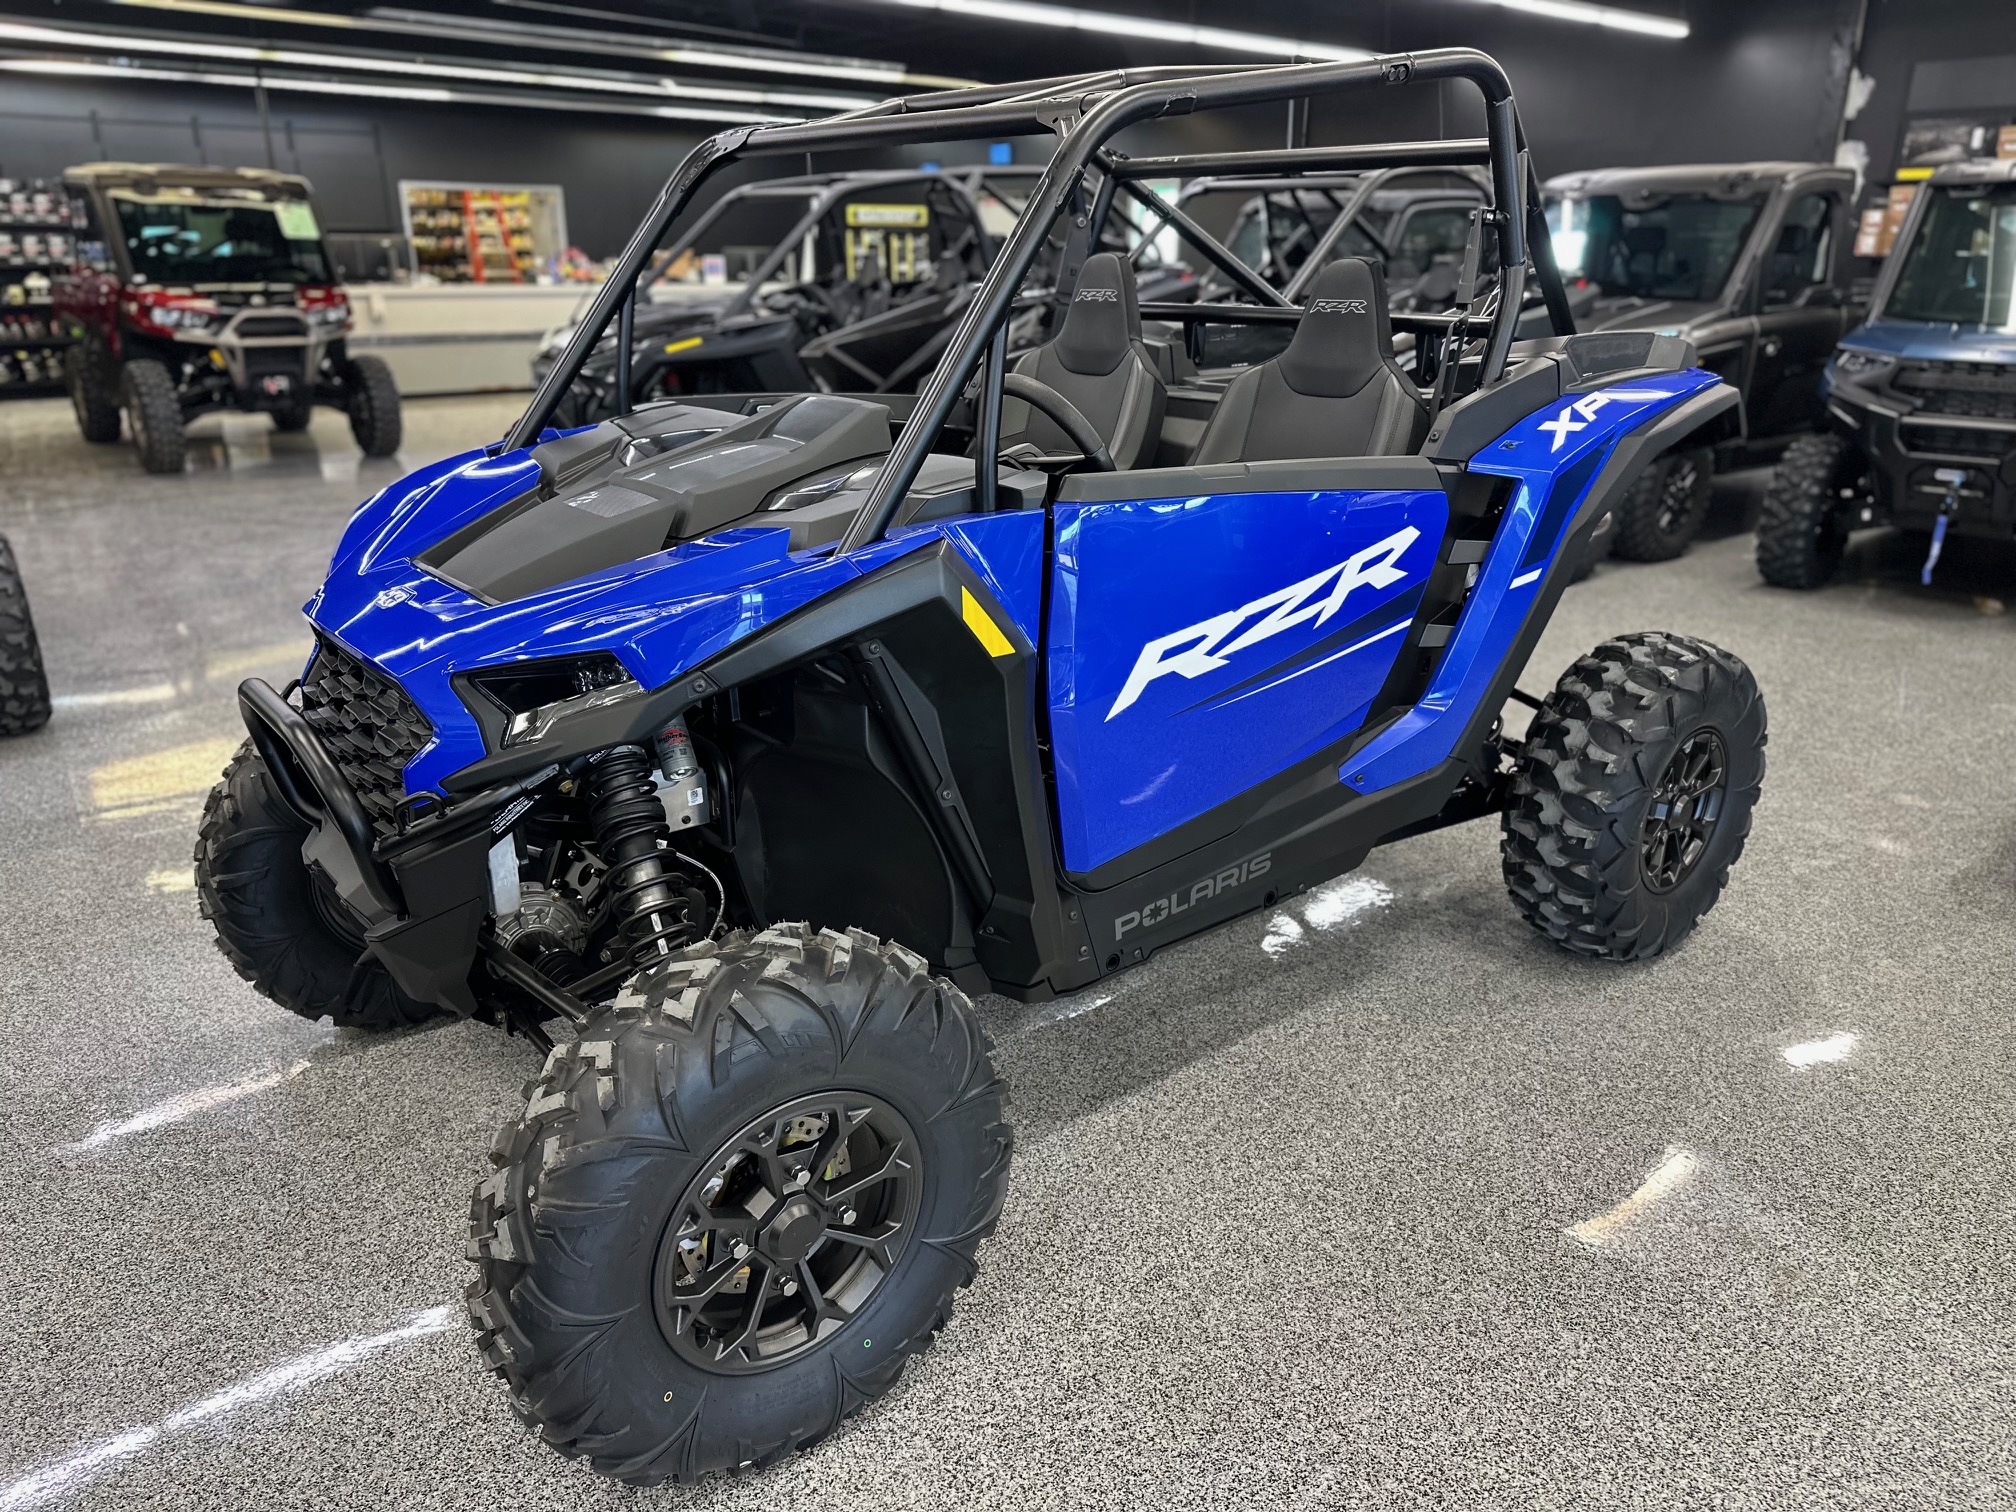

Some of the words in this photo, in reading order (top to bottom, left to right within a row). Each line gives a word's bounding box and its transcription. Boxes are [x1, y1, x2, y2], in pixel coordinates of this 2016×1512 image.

[1075, 287, 1118, 303] RZR
[1310, 298, 1367, 315] RZR
[1537, 391, 1612, 454] XP
[1104, 526, 1422, 723] RZR
[1114, 852, 1272, 942] POLARIS
